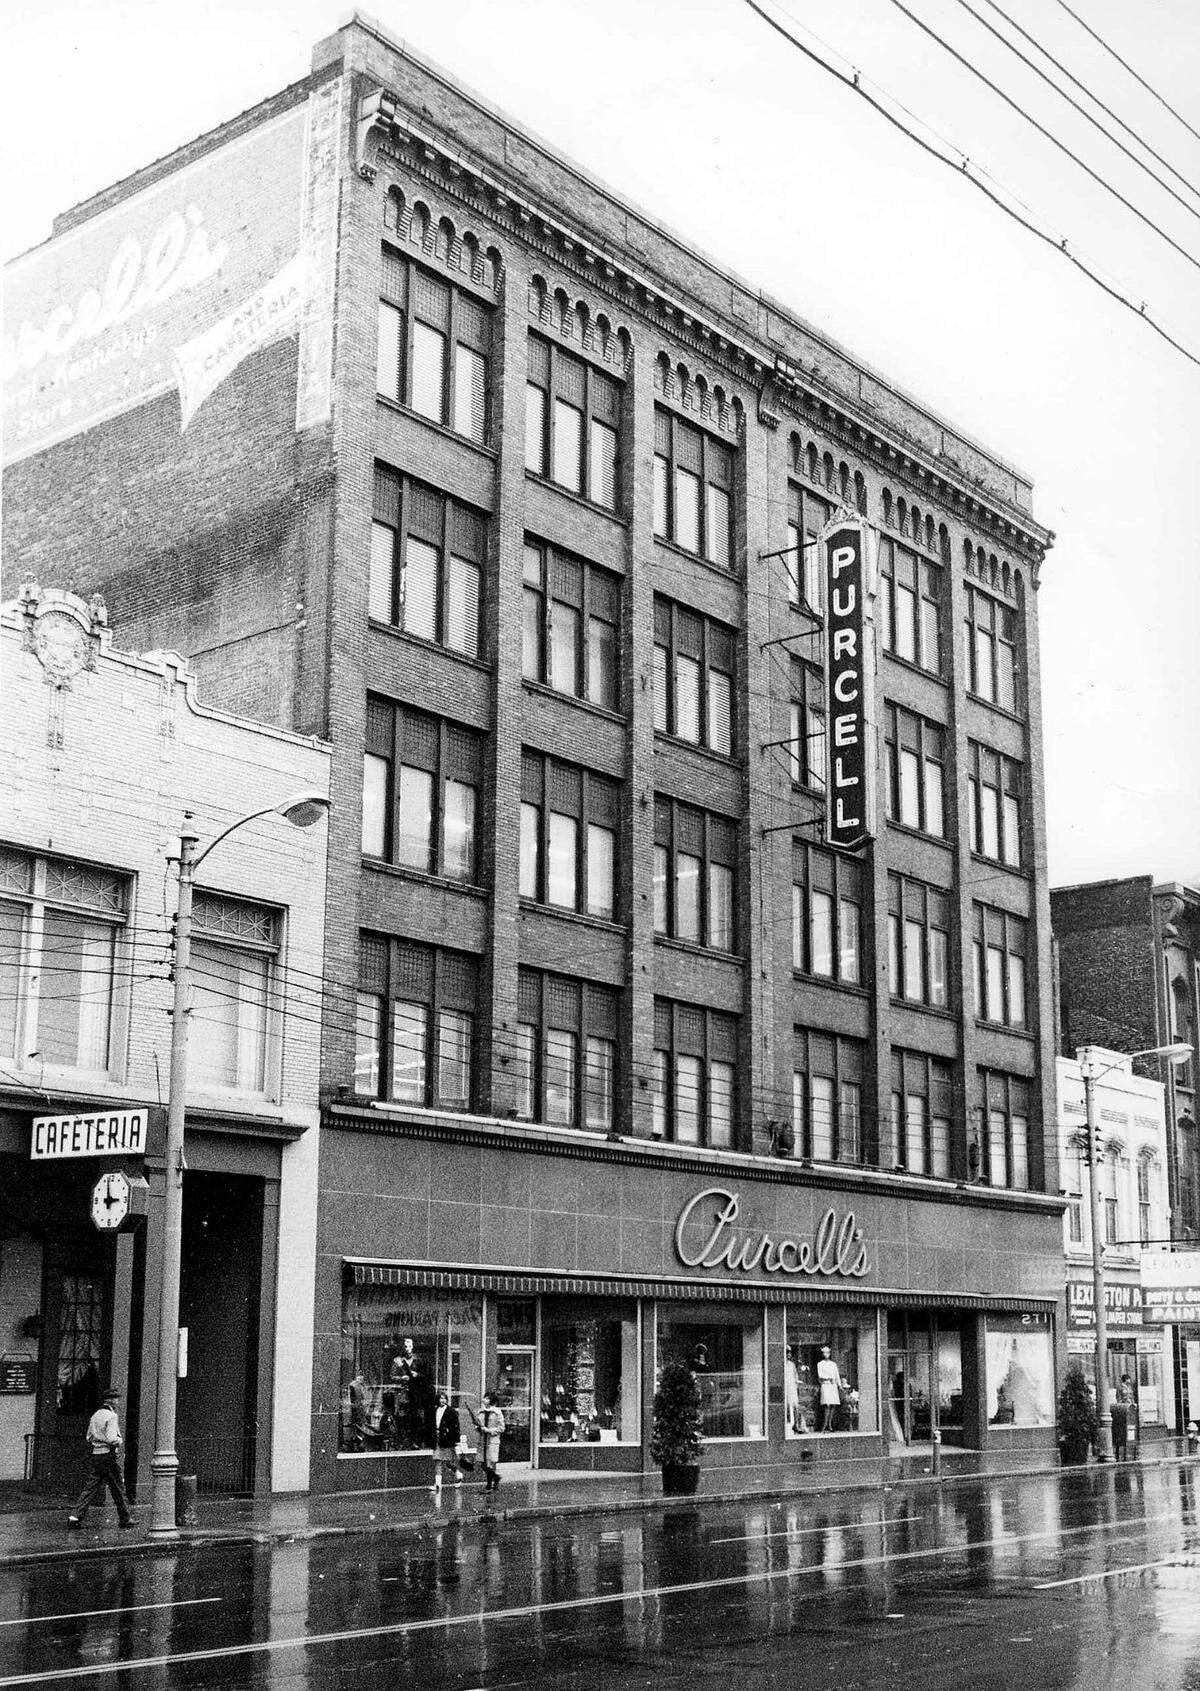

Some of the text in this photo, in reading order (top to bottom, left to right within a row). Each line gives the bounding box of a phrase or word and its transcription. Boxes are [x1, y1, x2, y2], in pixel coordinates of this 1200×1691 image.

[203, 286, 298, 371] CAFETERIA
[233, 296, 265, 326] AND
[832, 546, 860, 829] PURCELL
[35, 1115, 141, 1154] CAFETERIA
[676, 1187, 871, 1277] Purcell's
[1070, 1285, 1130, 1307] LEXIGTON
